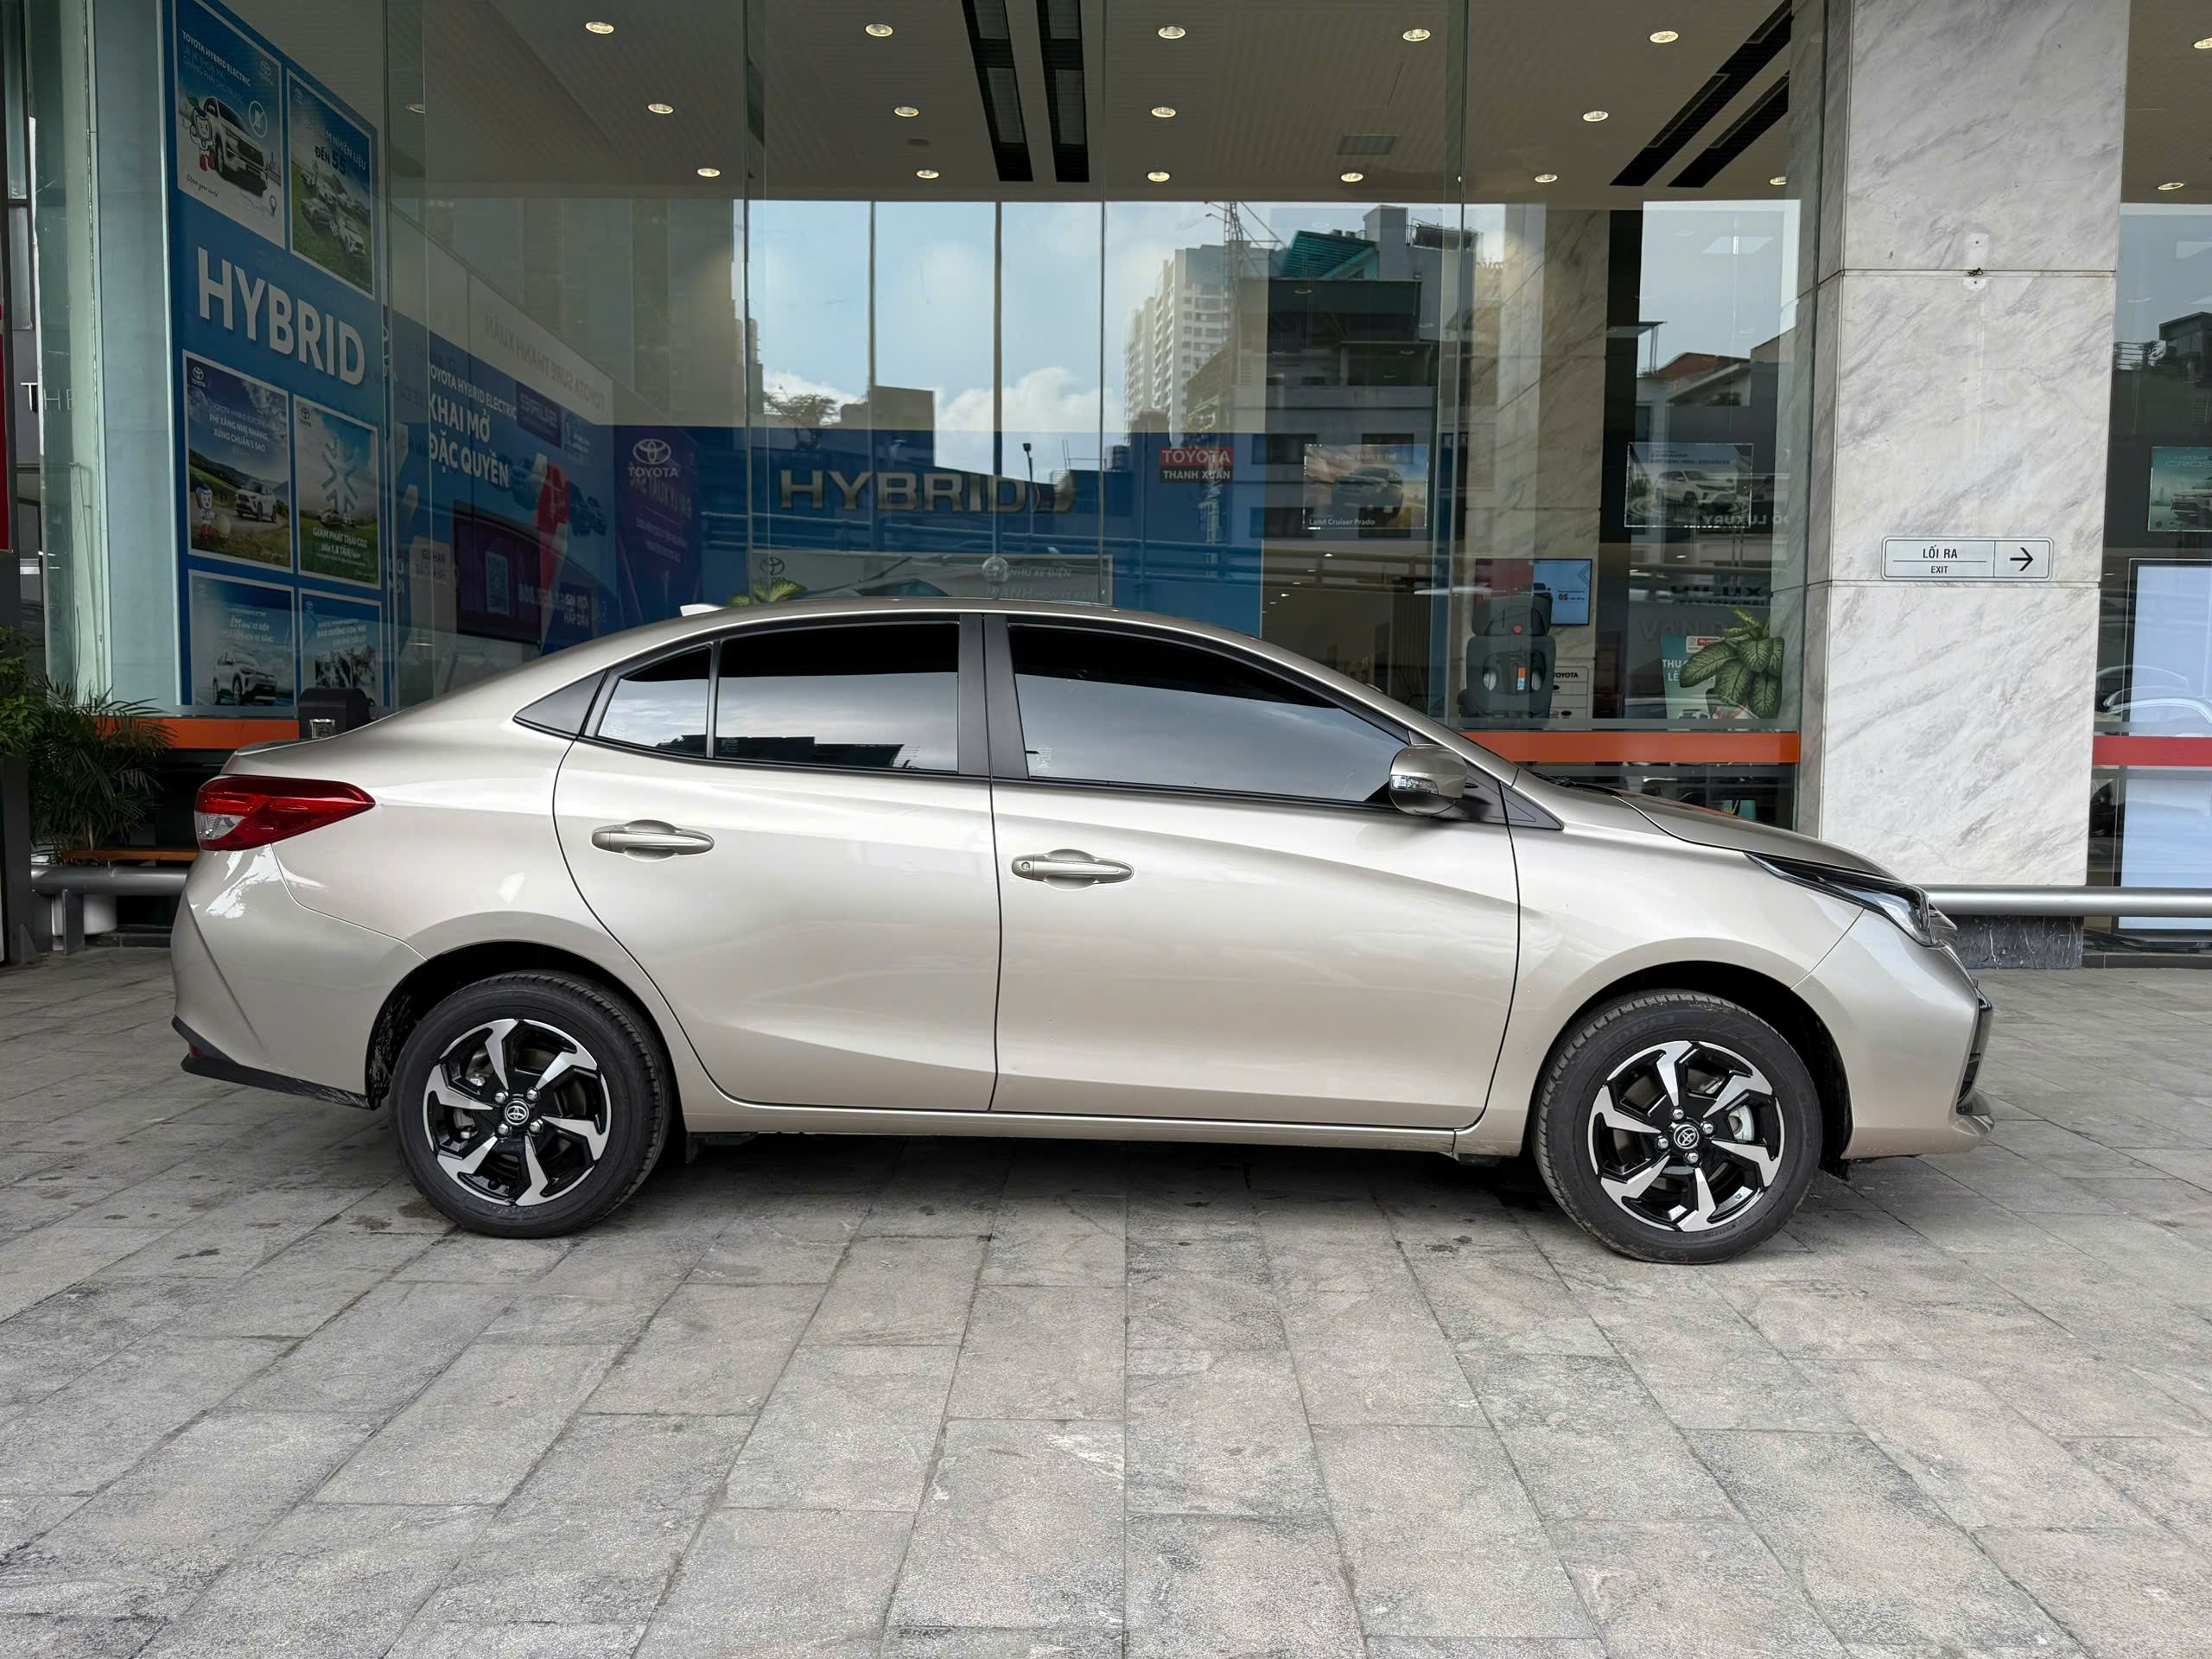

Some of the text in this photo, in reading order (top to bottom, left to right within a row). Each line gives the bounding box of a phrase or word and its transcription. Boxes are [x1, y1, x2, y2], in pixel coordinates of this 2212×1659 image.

[181, 30, 205, 54] TOYOTA
[206, 48, 226, 69] HYBRID
[226, 63, 251, 86] ELECTRIC
[198, 246, 365, 385] HYBRID
[429, 361, 517, 421] OYOTA HYBRID ELECTRIC
[429, 393, 464, 432] KHAI
[467, 408, 492, 443] MỞ
[429, 429, 509, 488] ĐẶC QUYỀN
[1162, 450, 1230, 464] TOYOTA
[627, 467, 679, 478] TOYOTA
[1163, 470, 1198, 480] THANH
[780, 469, 1027, 513] HYBRID
[1923, 545, 1958, 559] LỐI RA
[1930, 566, 1949, 575] EXIT
[1662, 659, 1681, 668] THU
